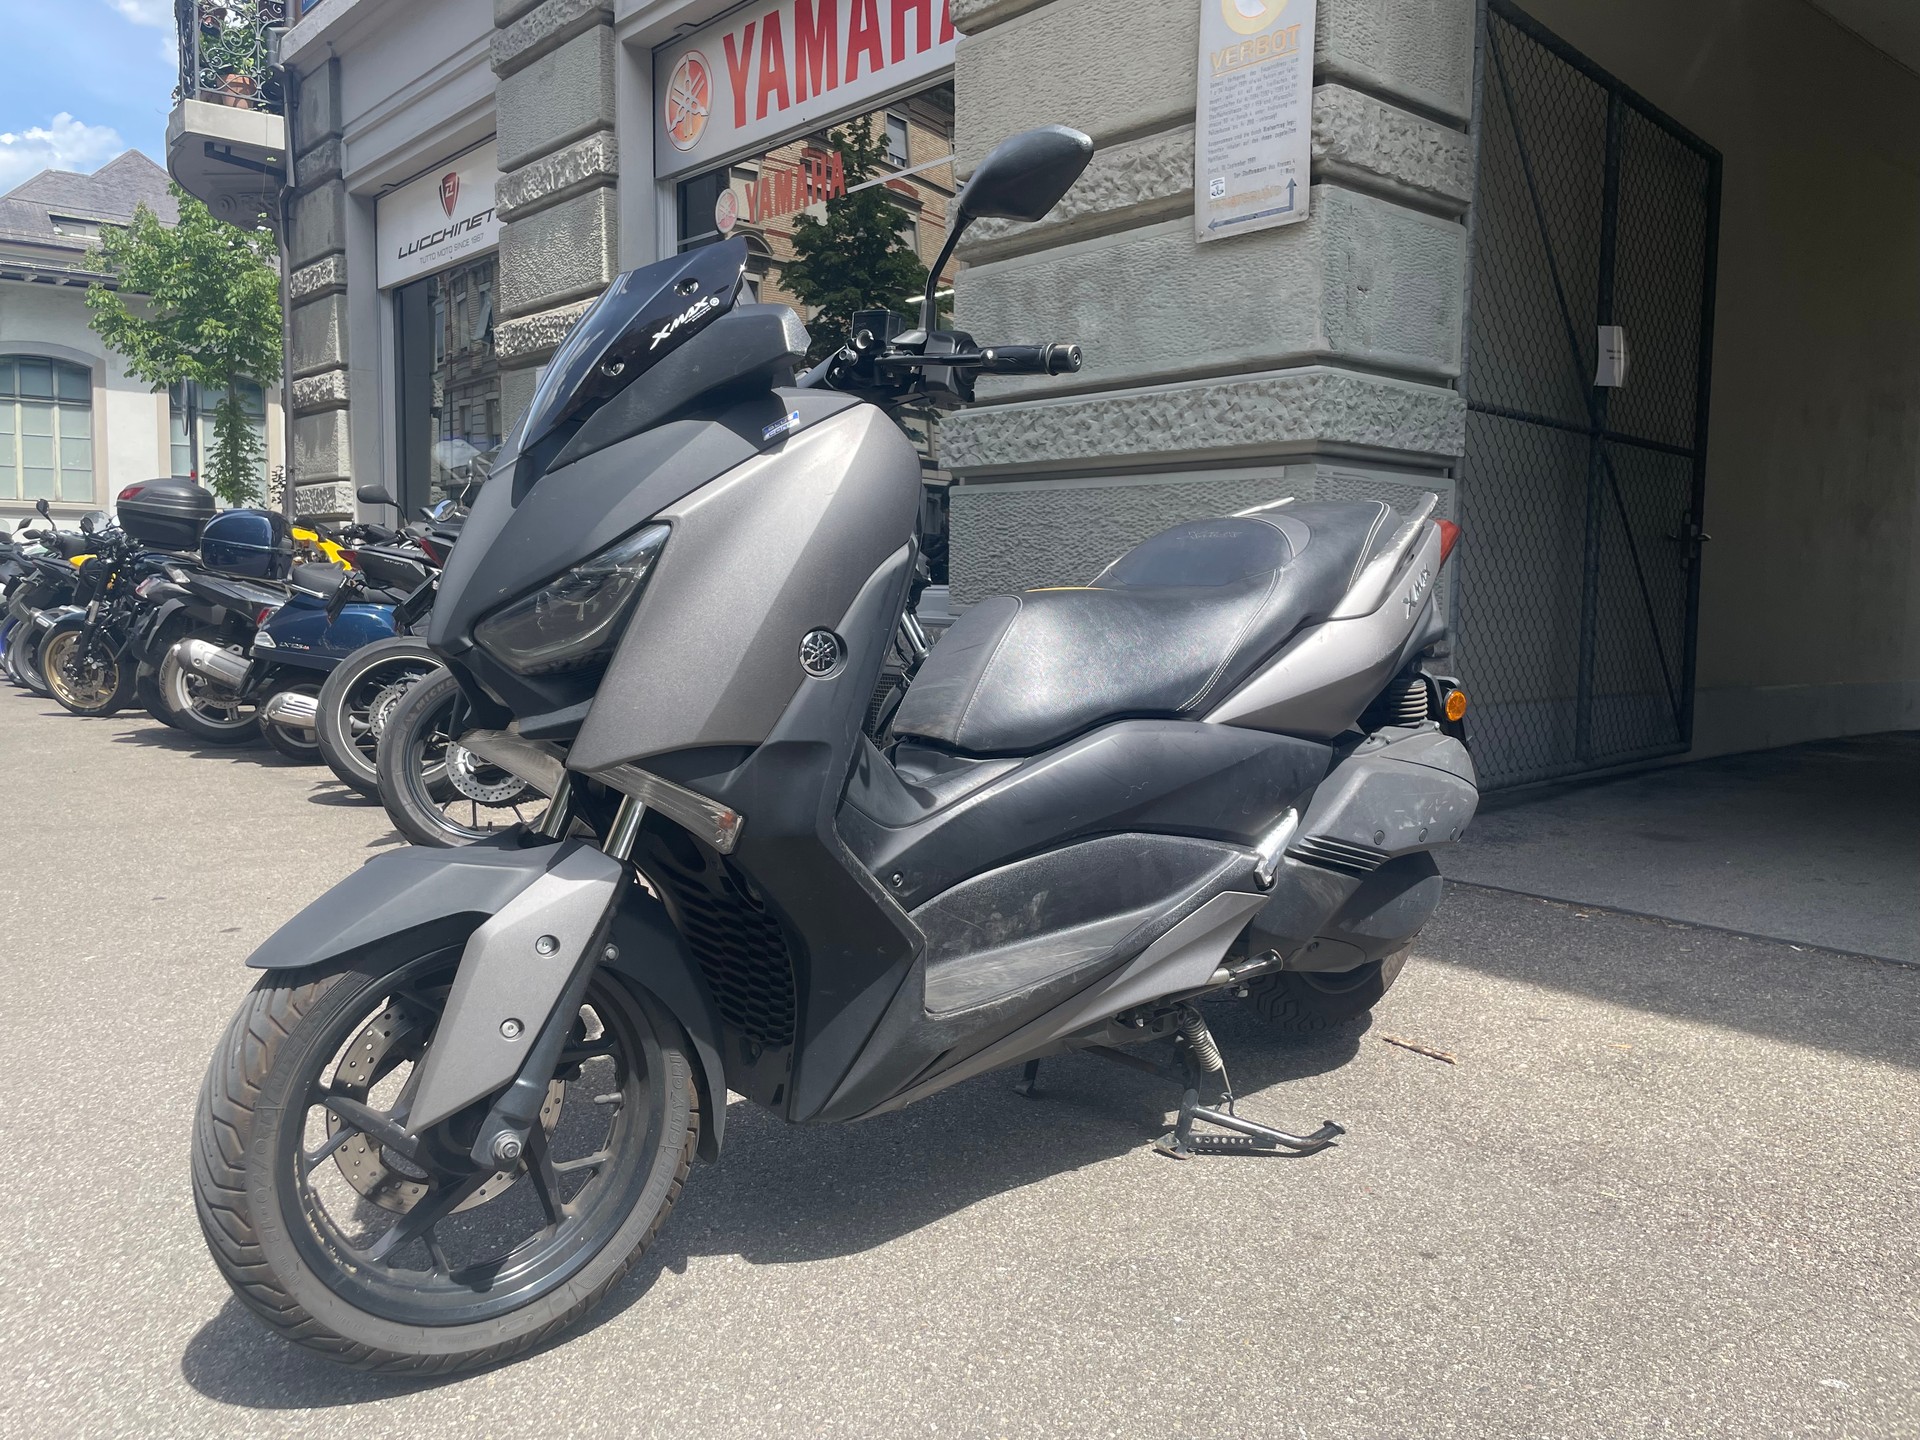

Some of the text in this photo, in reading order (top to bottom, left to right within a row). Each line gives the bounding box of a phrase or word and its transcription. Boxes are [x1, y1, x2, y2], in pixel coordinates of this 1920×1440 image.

[722, 0, 955, 129] YAMAH
[1210, 24, 1302, 71] VERBOT
[745, 152, 846, 224] YAMAHA
[398, 207, 495, 260] LUCCHINET
[420, 252, 437, 264] TUTTO
[437, 246, 453, 258] MOTO
[454, 239, 470, 251] SINCE
